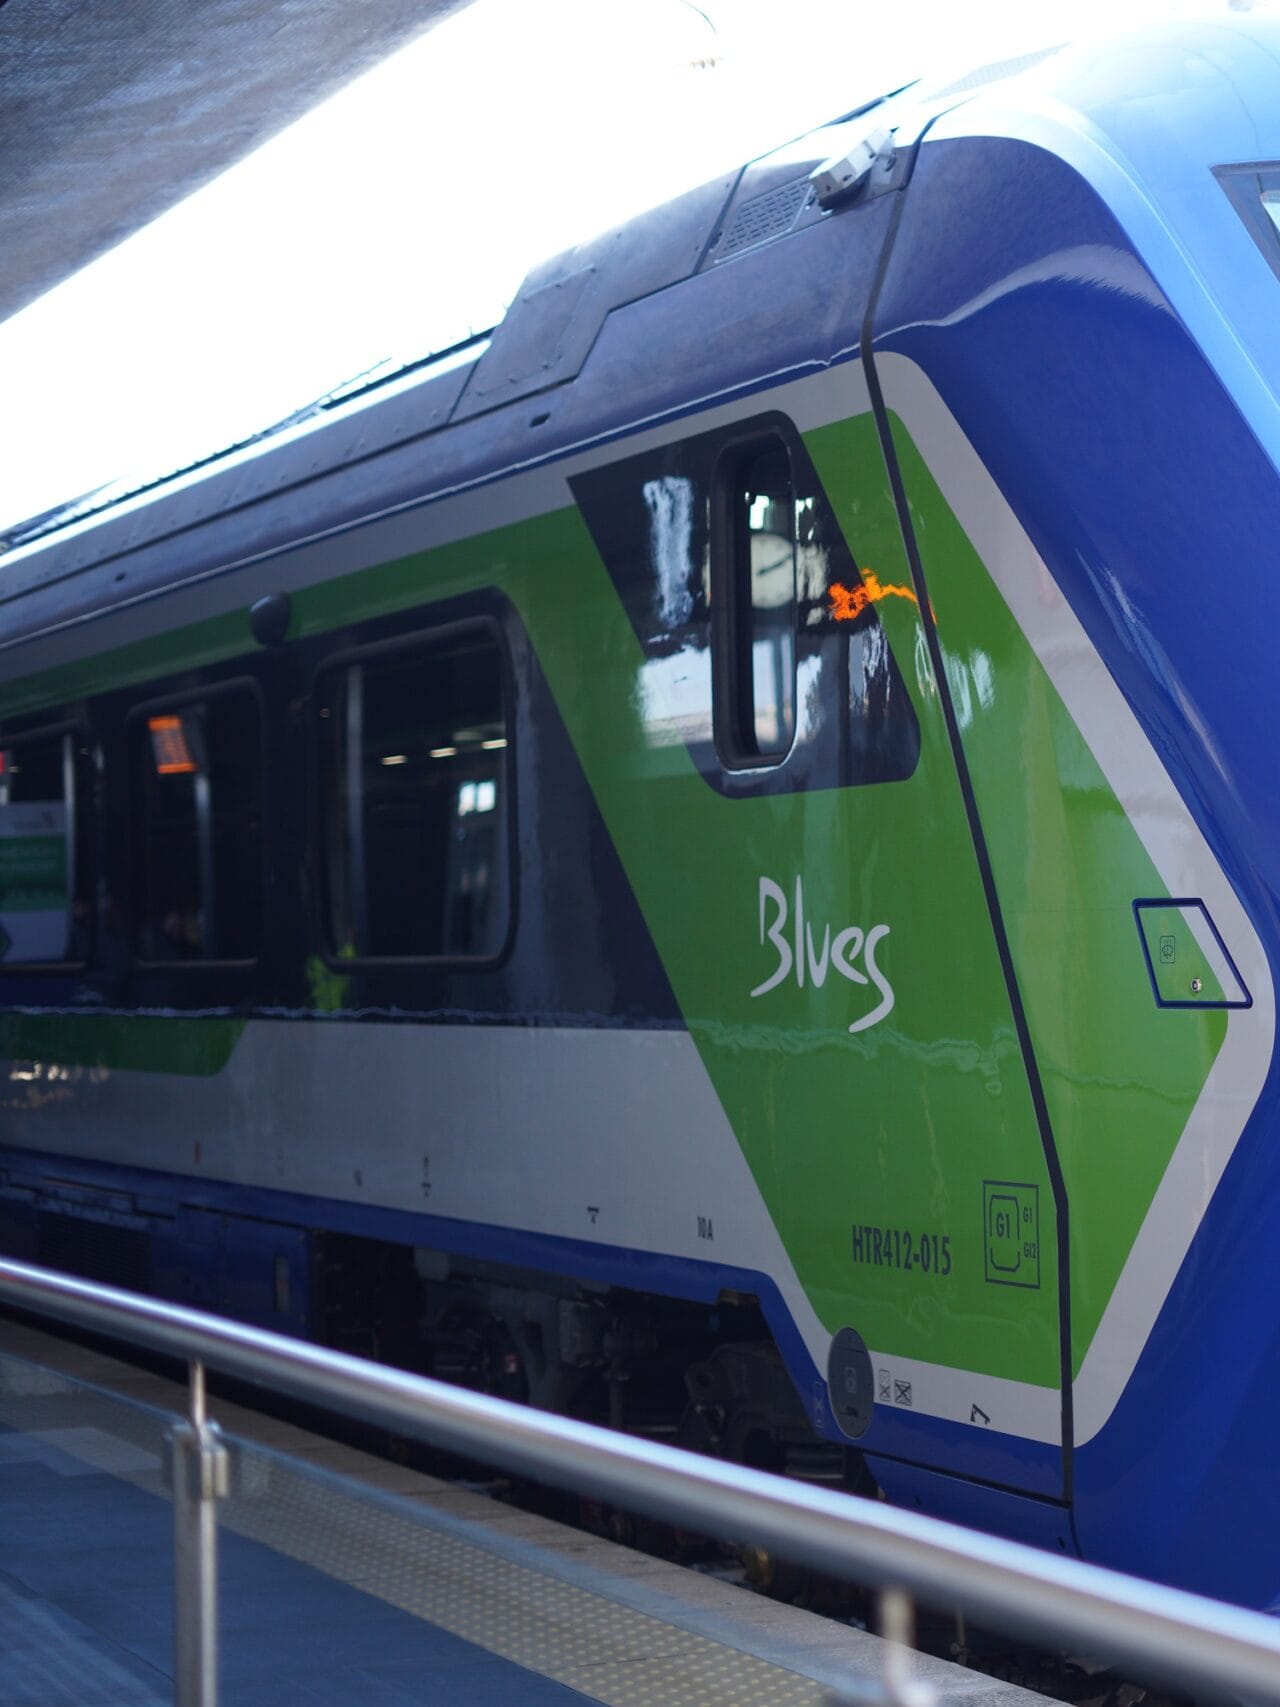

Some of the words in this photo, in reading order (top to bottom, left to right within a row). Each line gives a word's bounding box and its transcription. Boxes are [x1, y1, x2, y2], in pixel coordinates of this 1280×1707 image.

[750, 874, 895, 1033] Blues
[996, 1212, 1010, 1238] G1
[1023, 1207, 1033, 1224] G1
[852, 1224, 951, 1275] HTR412-015
